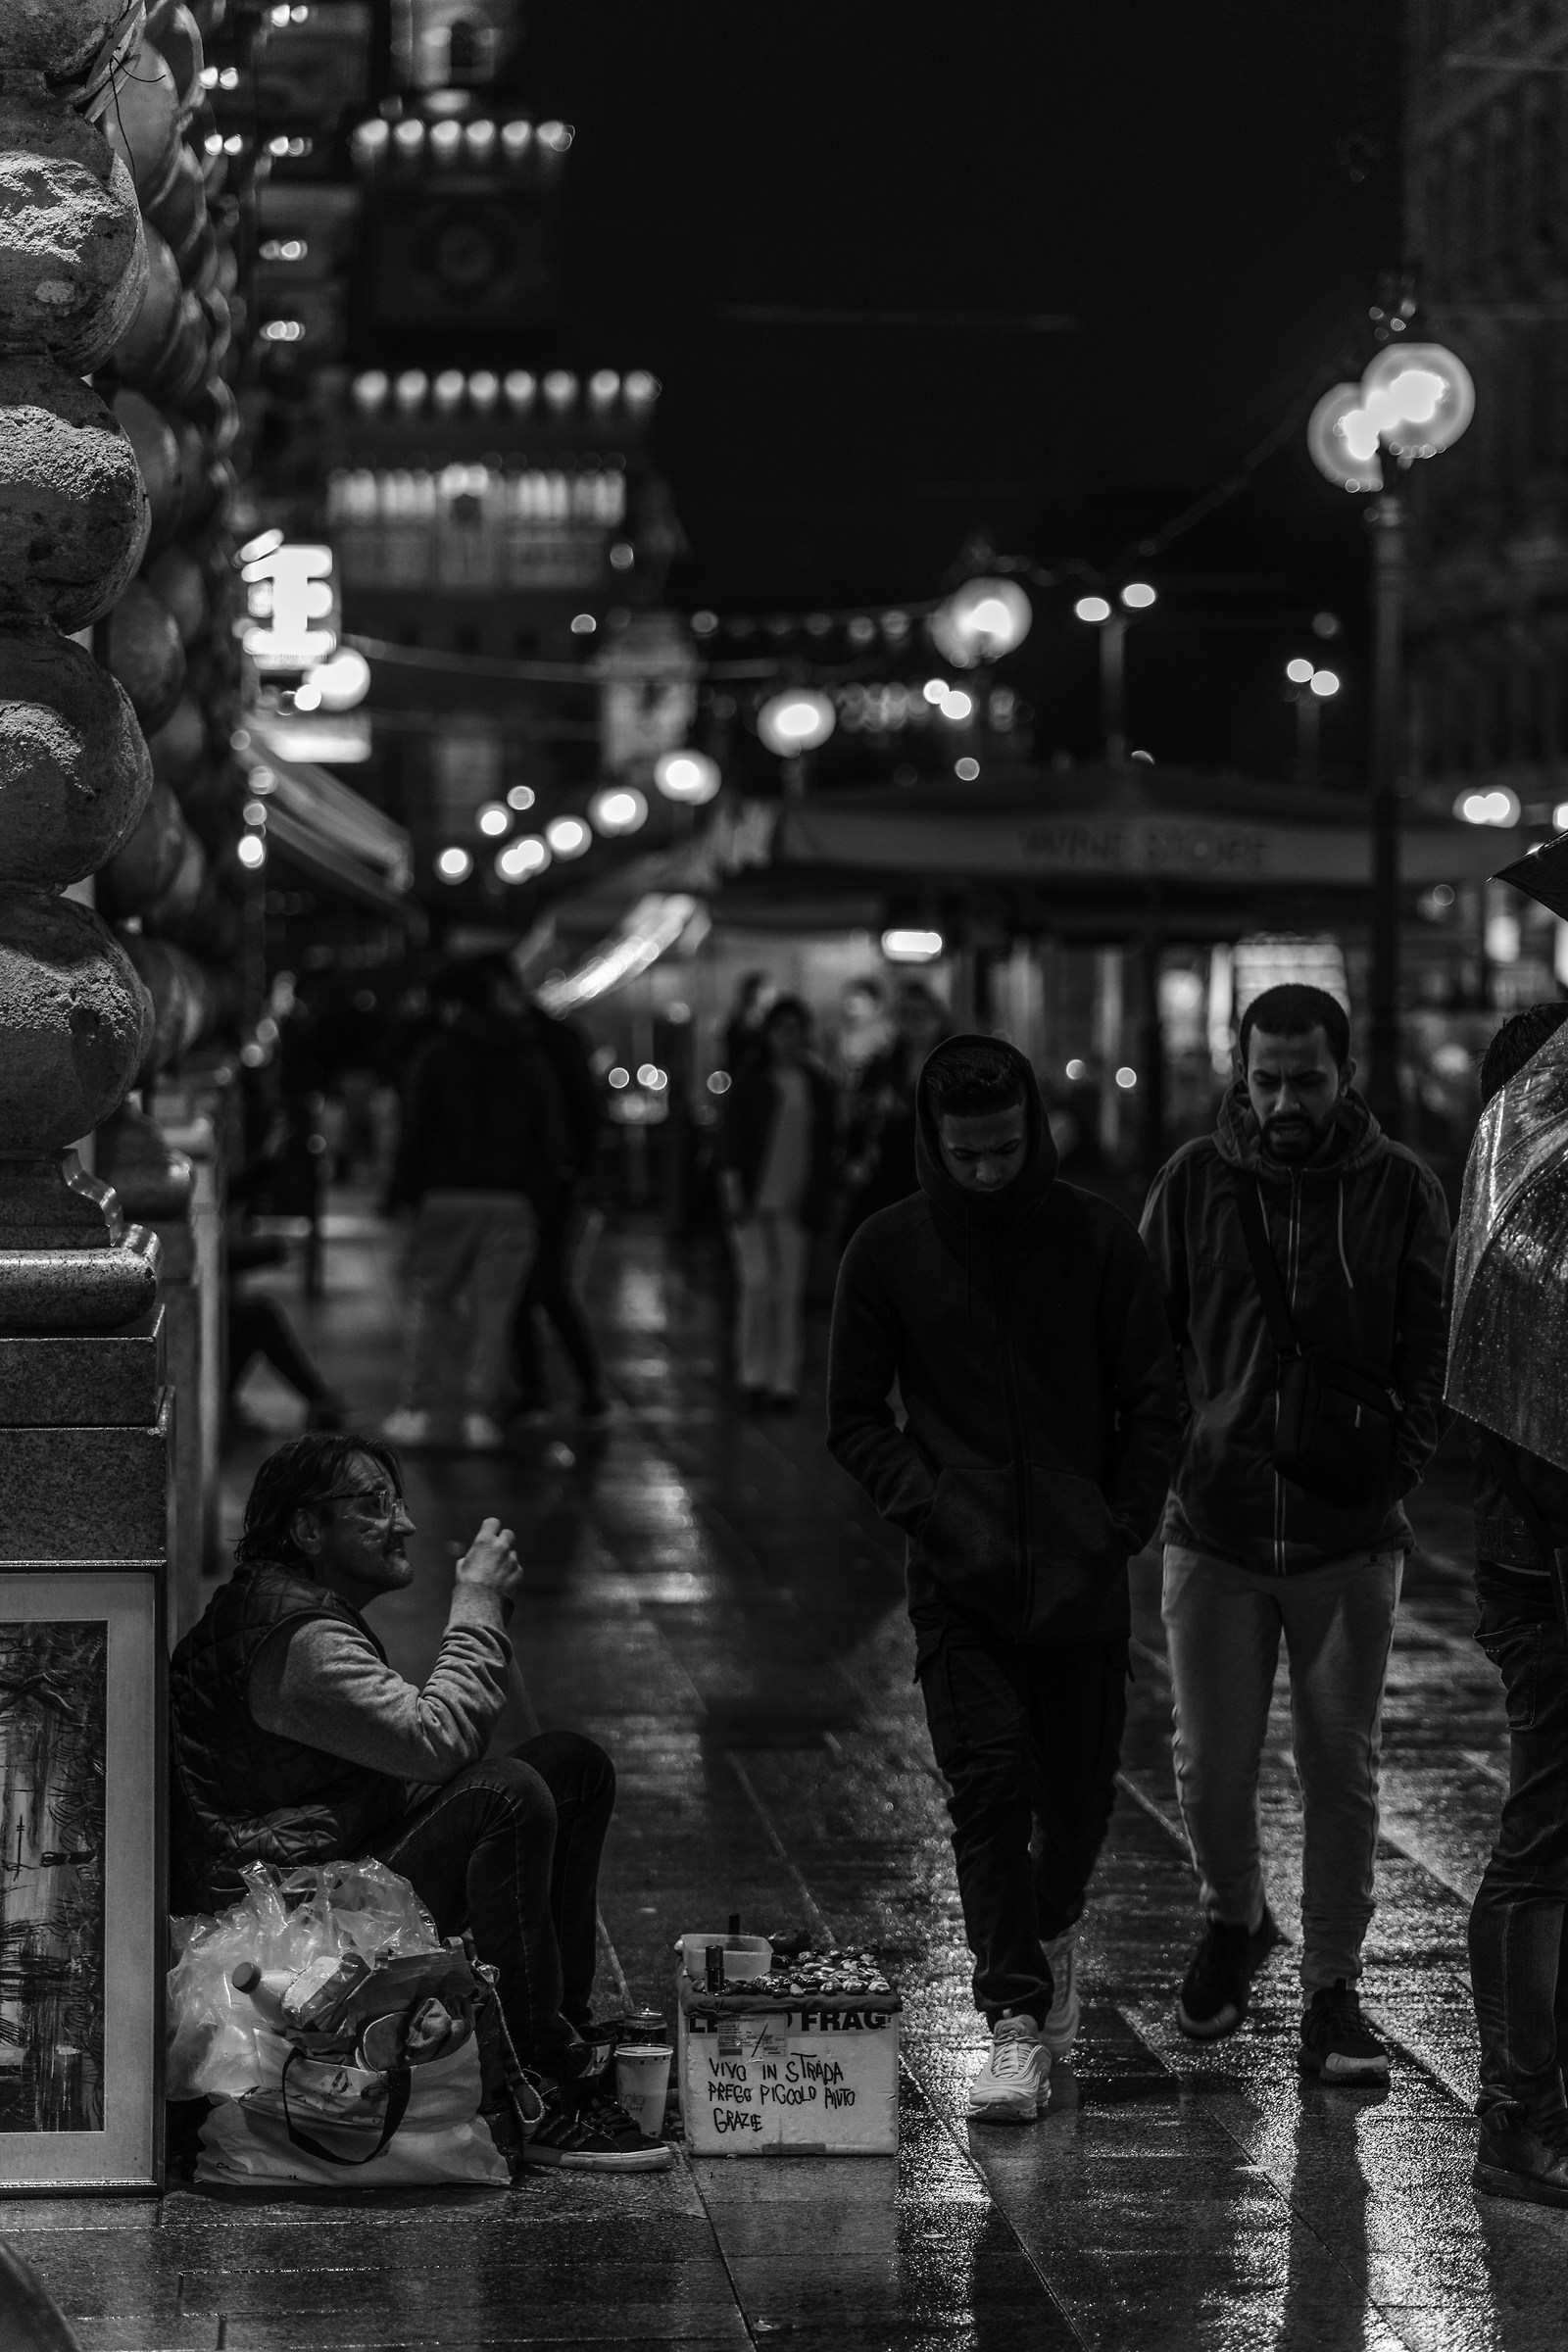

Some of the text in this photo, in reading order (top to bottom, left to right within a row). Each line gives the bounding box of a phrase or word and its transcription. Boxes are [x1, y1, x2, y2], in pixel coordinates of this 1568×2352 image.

[709, 2052, 844, 2085] VIVO IN STRADA
[708, 2081, 752, 2103] PREGO
[760, 2083, 816, 2105] PICCOLO
[713, 2107, 762, 2133] GRAZIE
